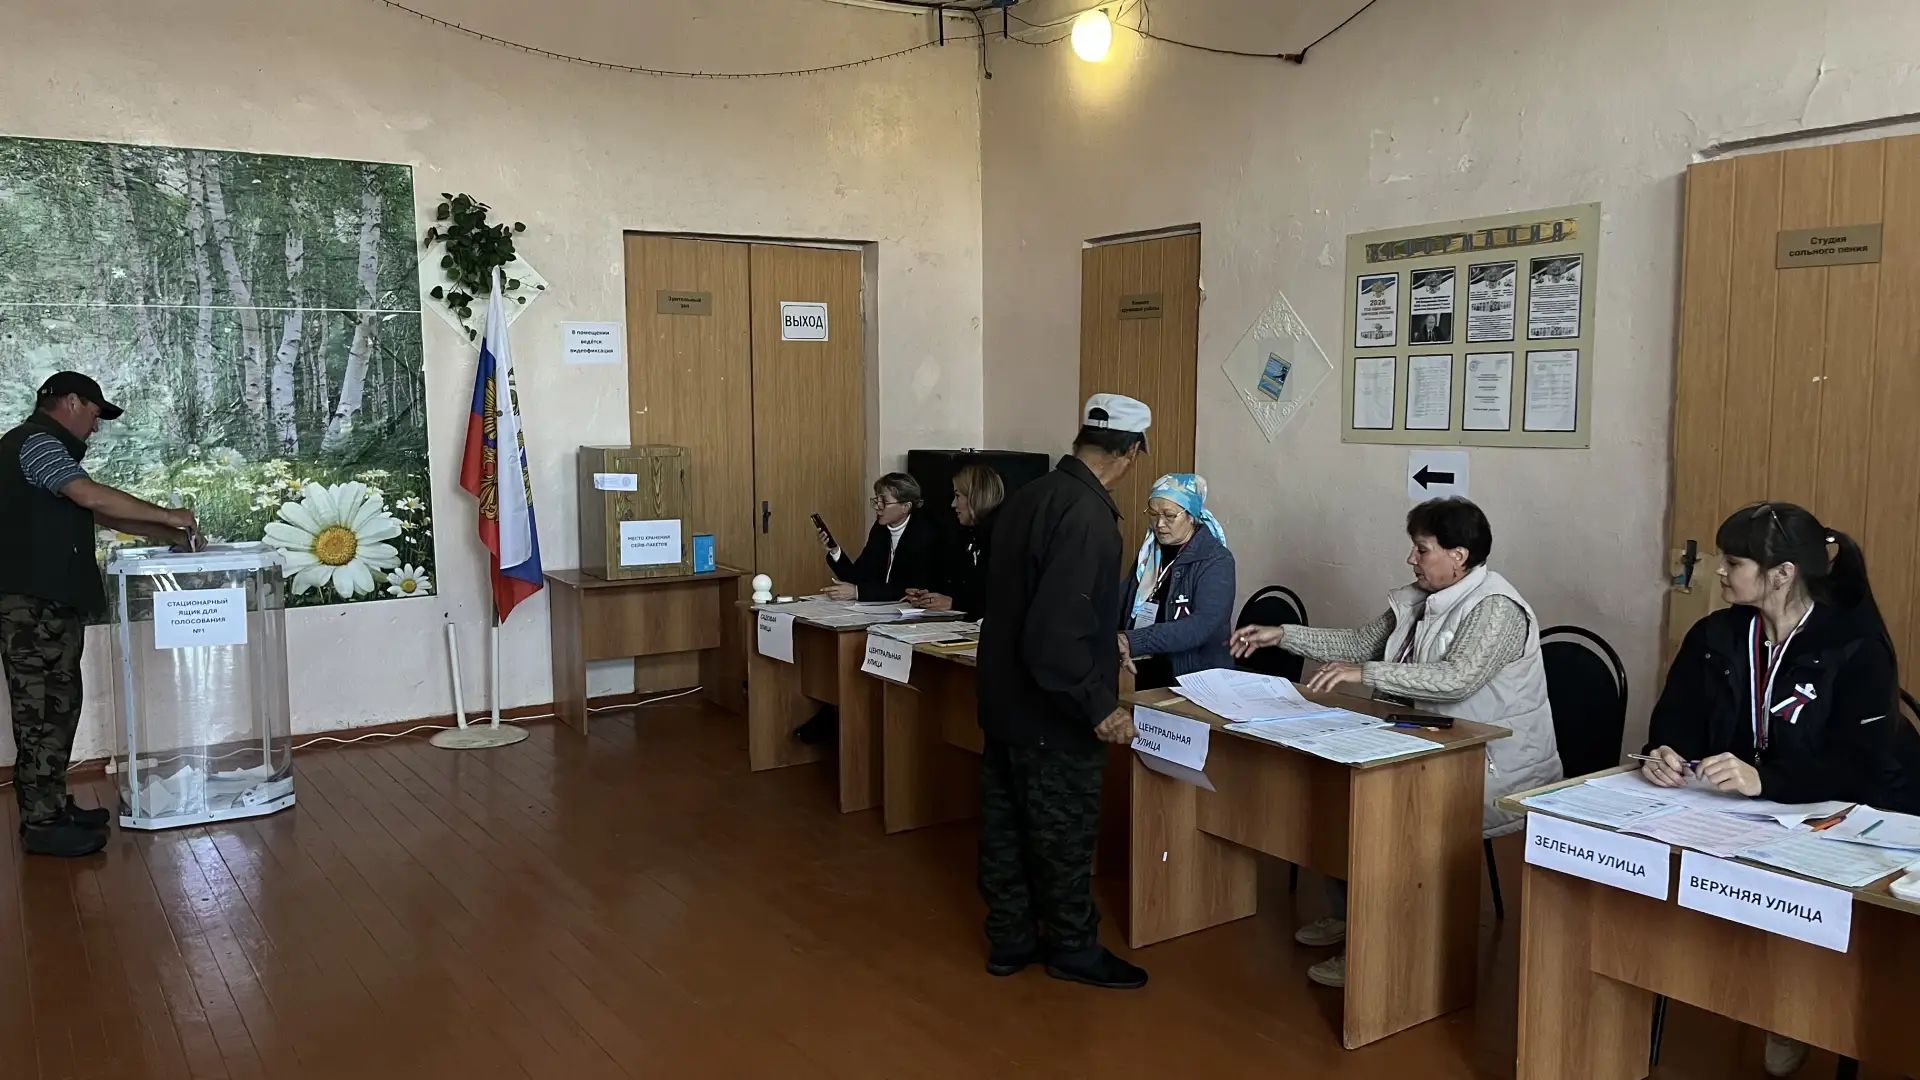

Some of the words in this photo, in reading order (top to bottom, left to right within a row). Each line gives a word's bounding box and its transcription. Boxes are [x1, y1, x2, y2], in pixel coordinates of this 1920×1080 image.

[1810, 236, 1847, 246] Студия
[1788, 248, 1835, 257] сольного
[1837, 245, 1869, 254] пения
[785, 315, 824, 330] ВЫХОД
[166, 597, 228, 607] СТАЦИОНАРНЫЙ
[202, 608, 218, 616] ДЛЯ
[171, 616, 226, 626] ГОЛОСОВАНИЯ
[868, 646, 902, 661] ЦЕНТРАЛЬНАЯ
[867, 657, 883, 668] УЛИЦА
[1138, 721, 1192, 746] ЦЕНТРАЛЬНАЯ
[1137, 737, 1161, 752] УЛИЦА
[1534, 834, 1595, 862] ЗЕЛЕНАЯ
[1597, 852, 1647, 878] УЛИЦА
[1690, 875, 1762, 906] ВЕРХНЯЯ
[1765, 895, 1823, 924] УЛИЦА
